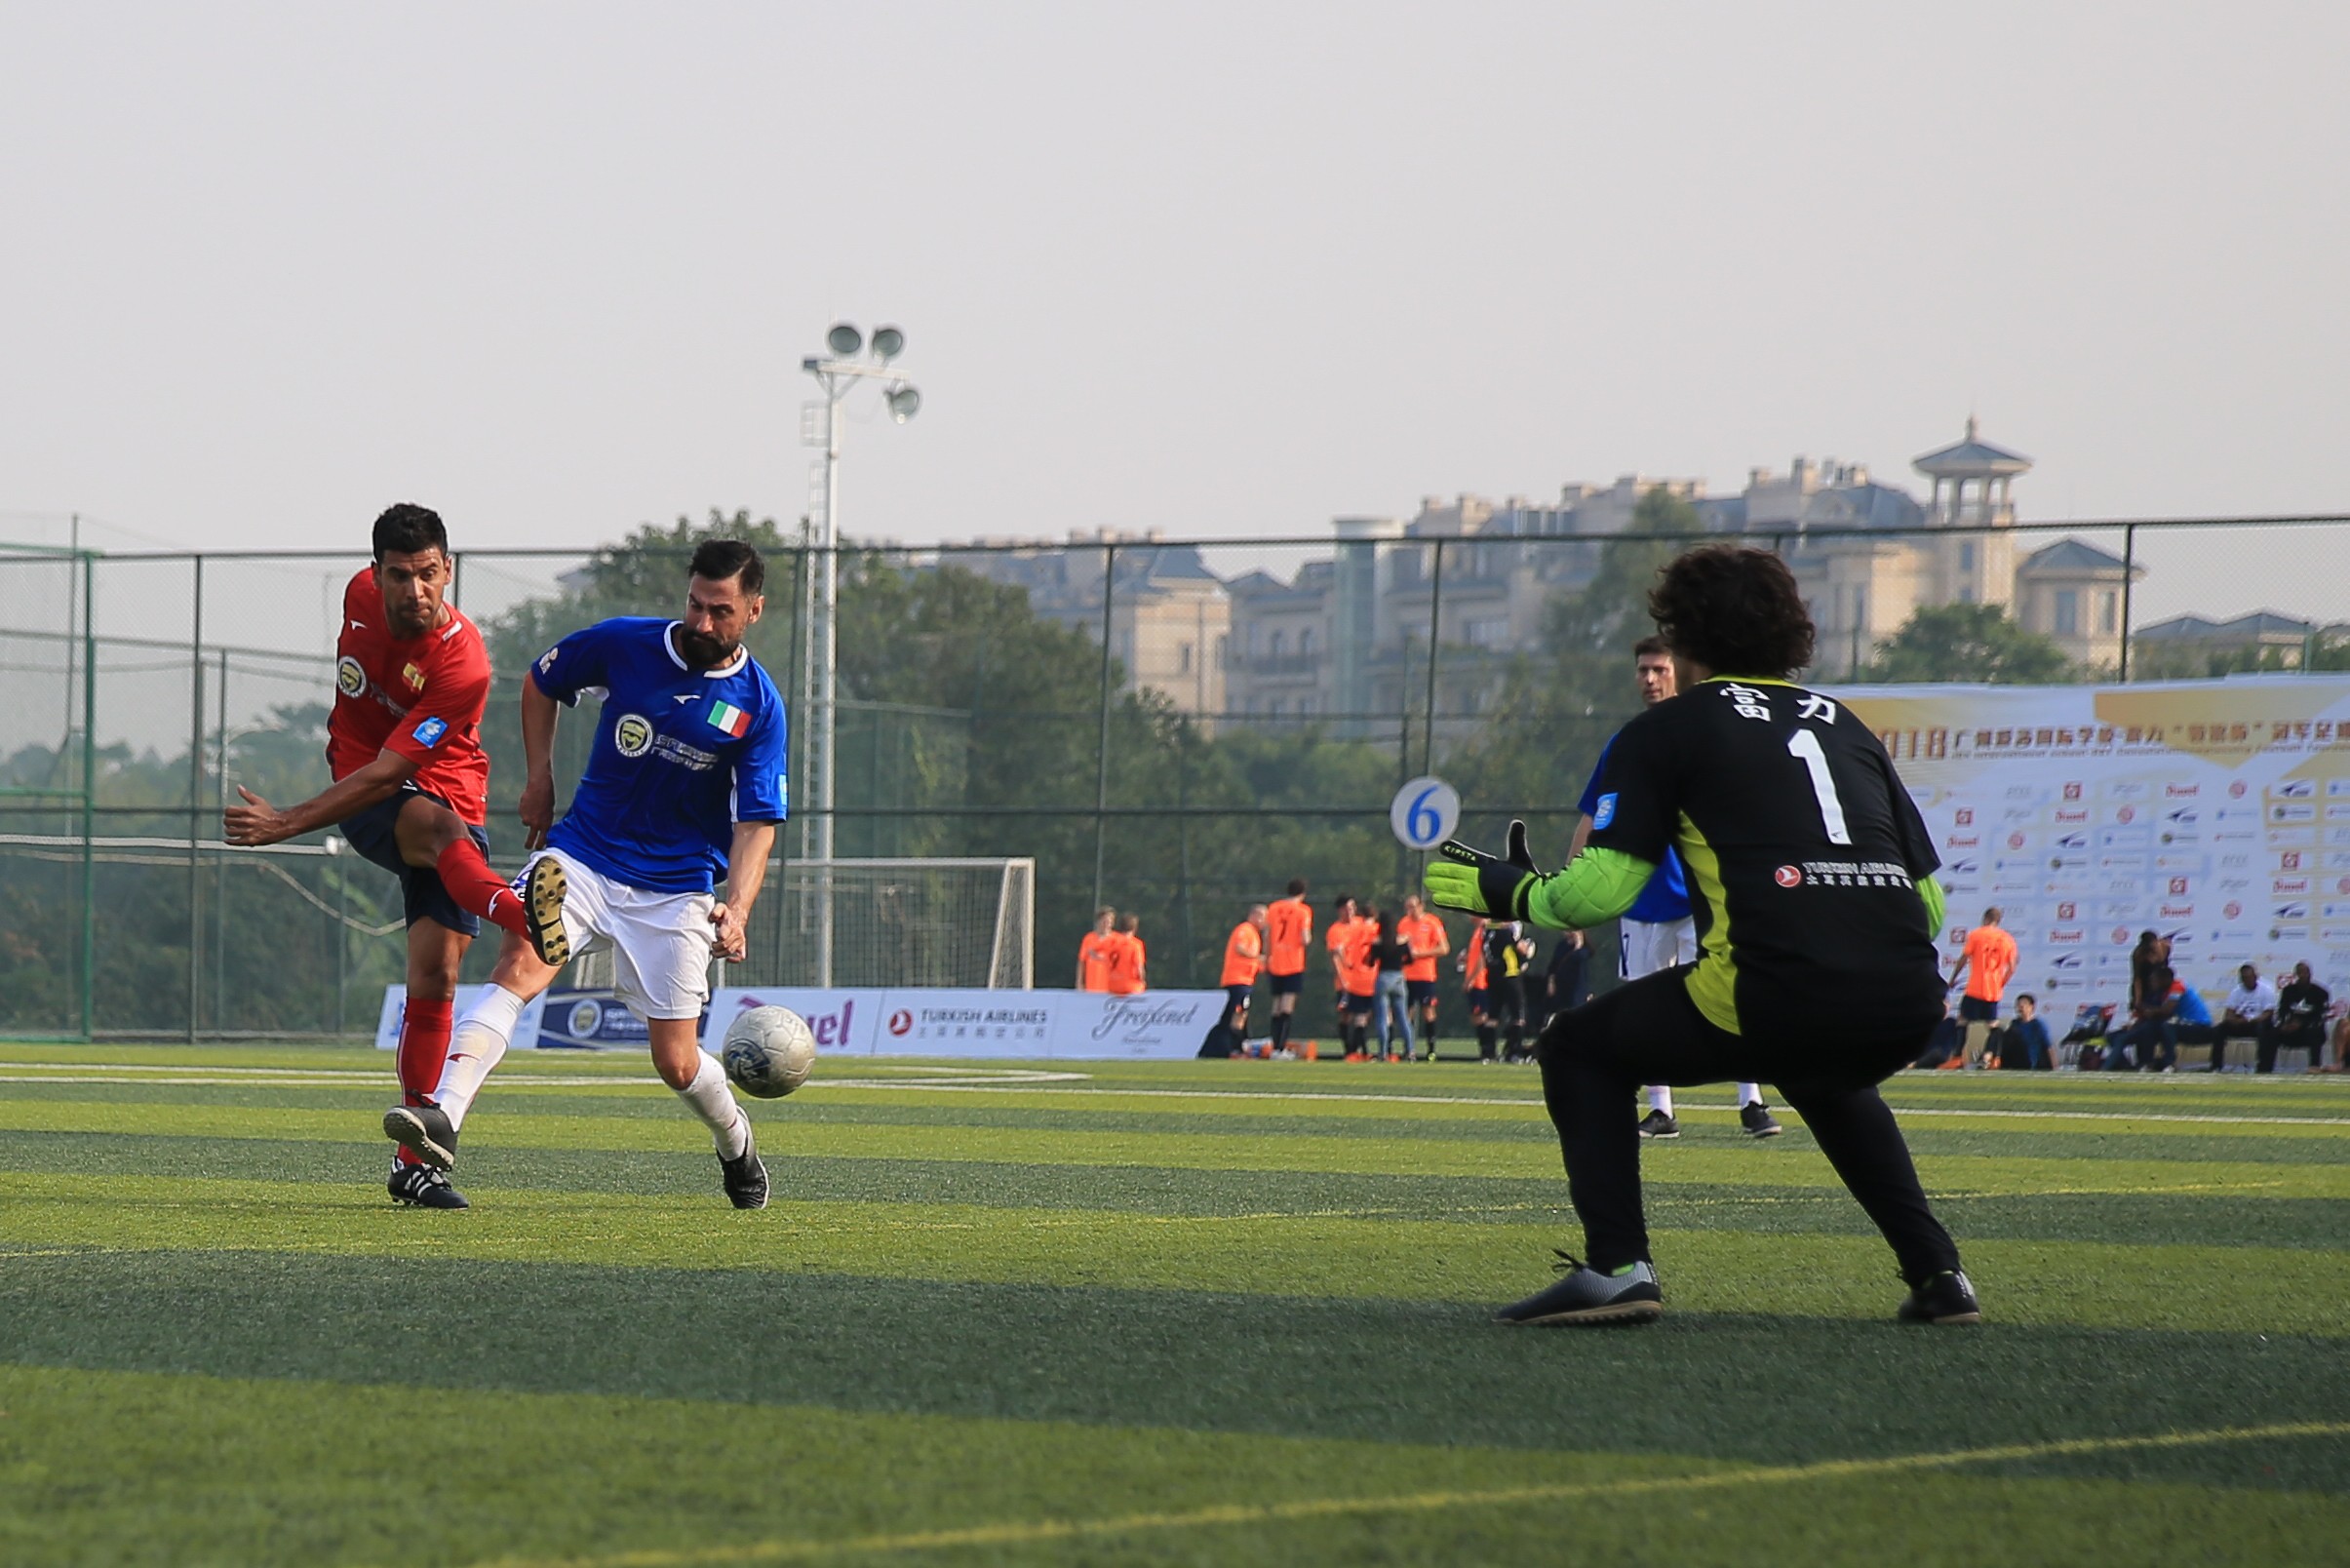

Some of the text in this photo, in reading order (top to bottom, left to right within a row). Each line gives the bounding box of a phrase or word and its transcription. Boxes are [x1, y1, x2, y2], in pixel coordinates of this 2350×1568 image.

[1720, 683, 1836, 725] 富力
[1787, 728, 1852, 844] 1
[1408, 785, 1441, 843] 6
[1444, 844, 1477, 862] KIPSTA
[920, 1007, 1047, 1023] TURKISH AIRLINES
